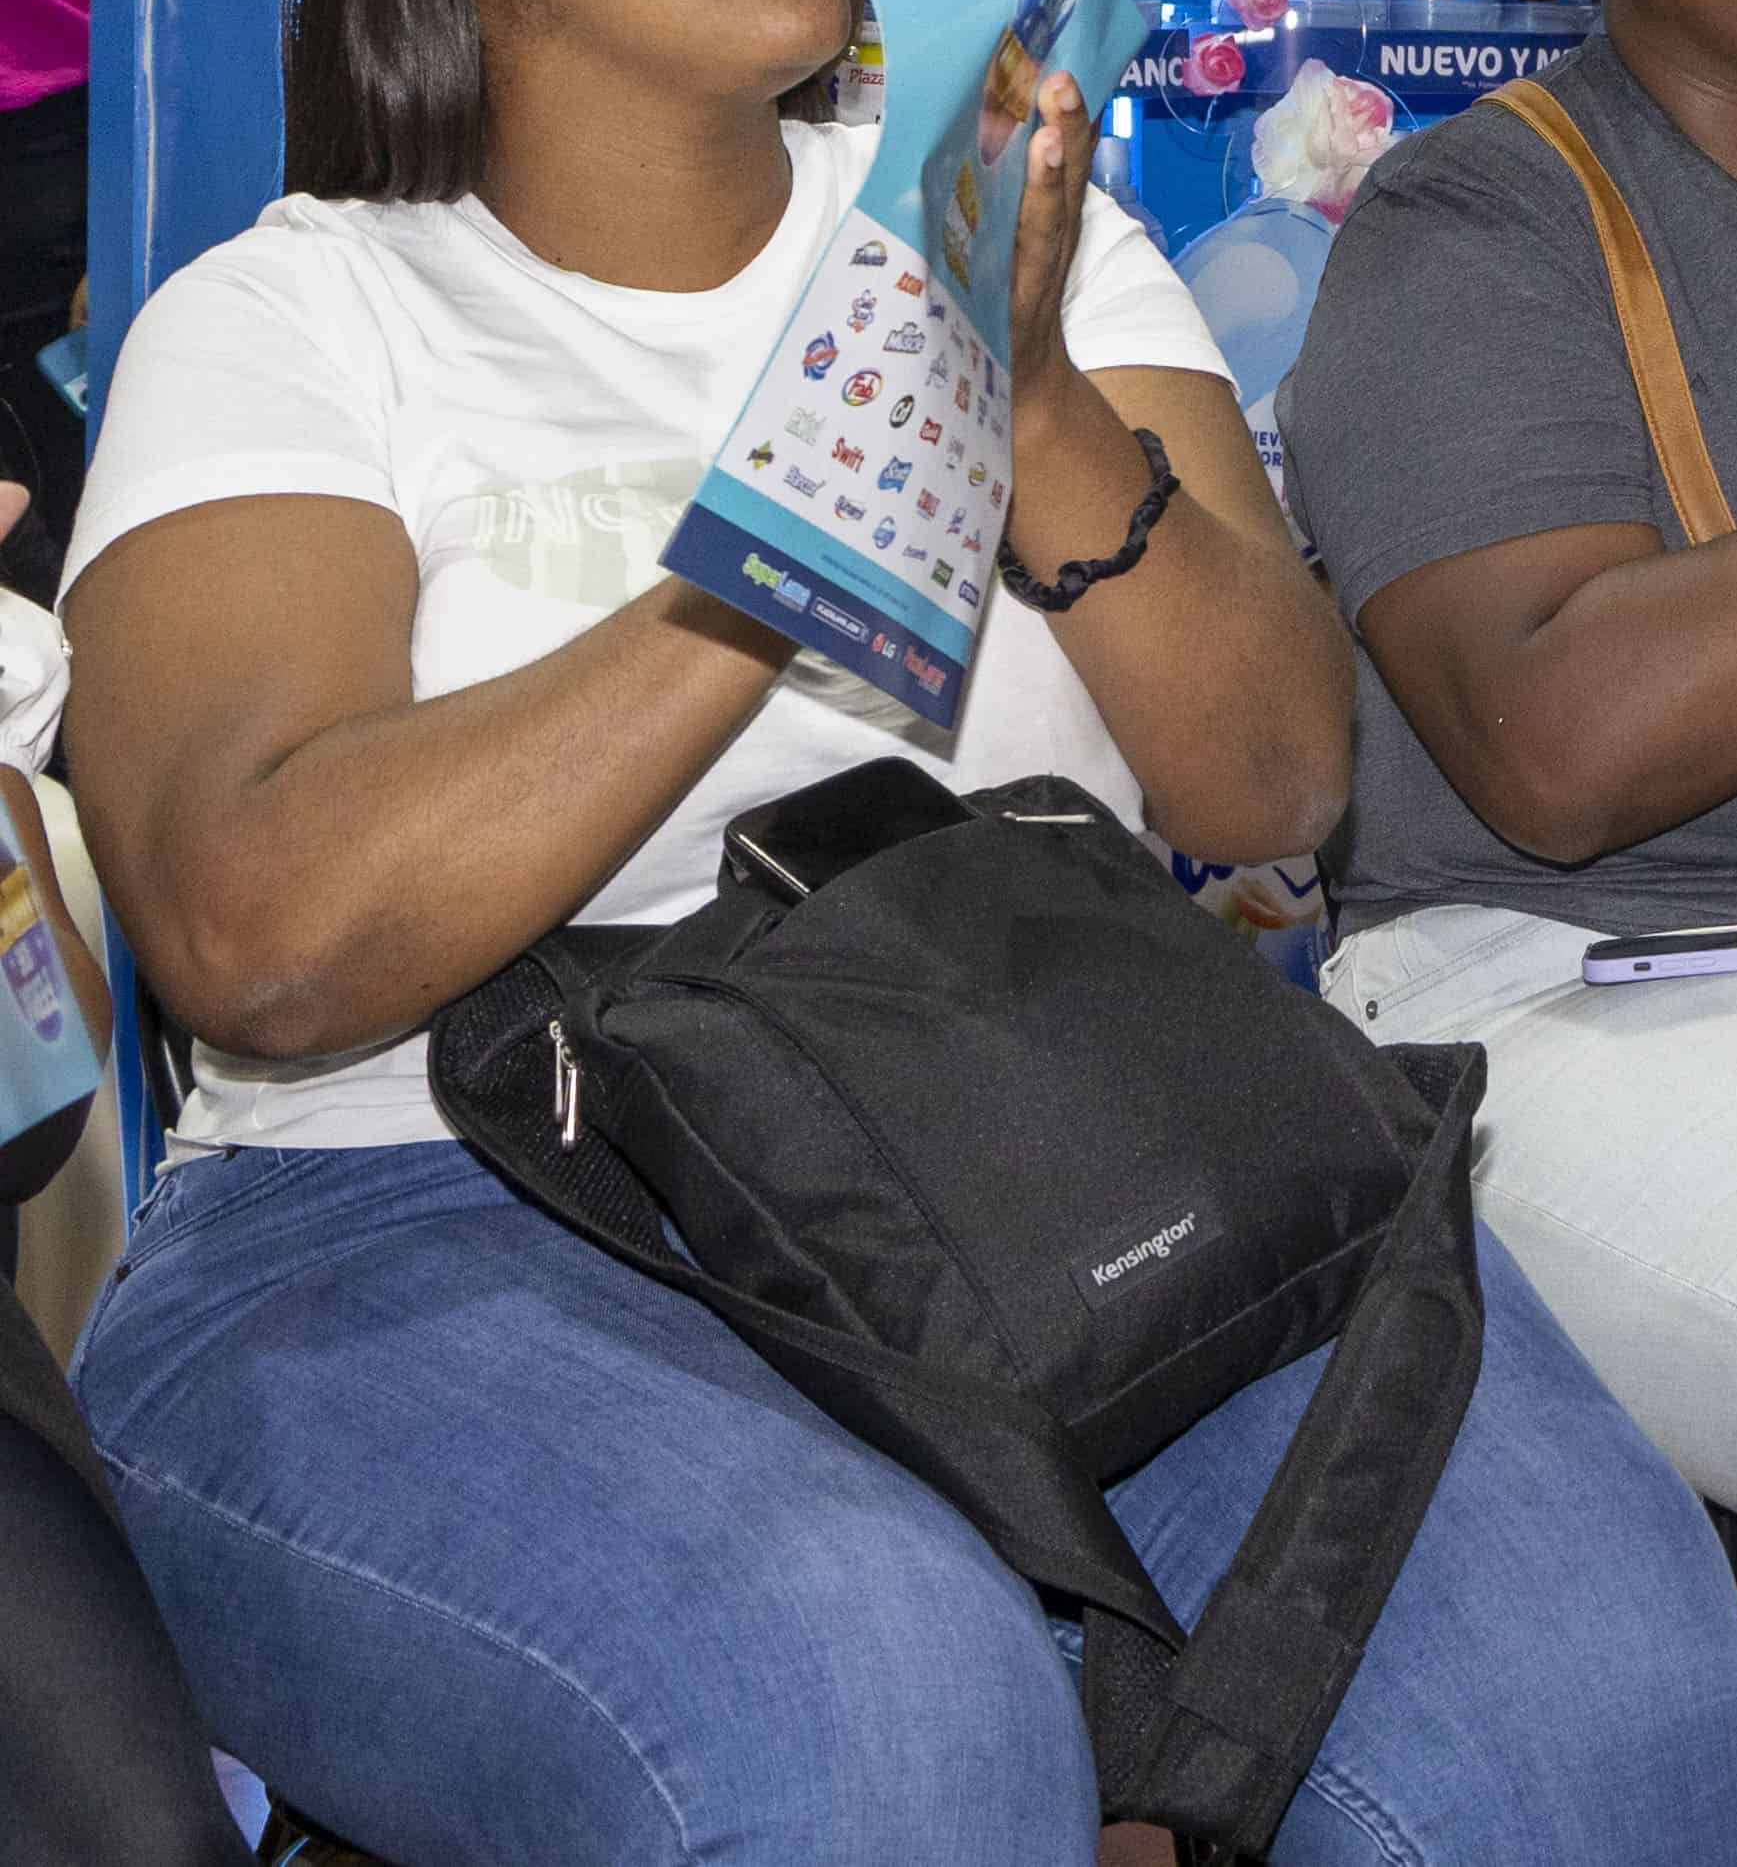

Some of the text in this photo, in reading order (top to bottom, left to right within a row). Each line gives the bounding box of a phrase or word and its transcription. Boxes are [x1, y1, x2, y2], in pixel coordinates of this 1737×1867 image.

[1380, 44, 1501, 77] NUEVO
[1510, 46, 1526, 77] Y
[847, 372, 875, 399] Fab
[831, 437, 865, 474] Swift
[1091, 1217, 1195, 1287] Kensington
